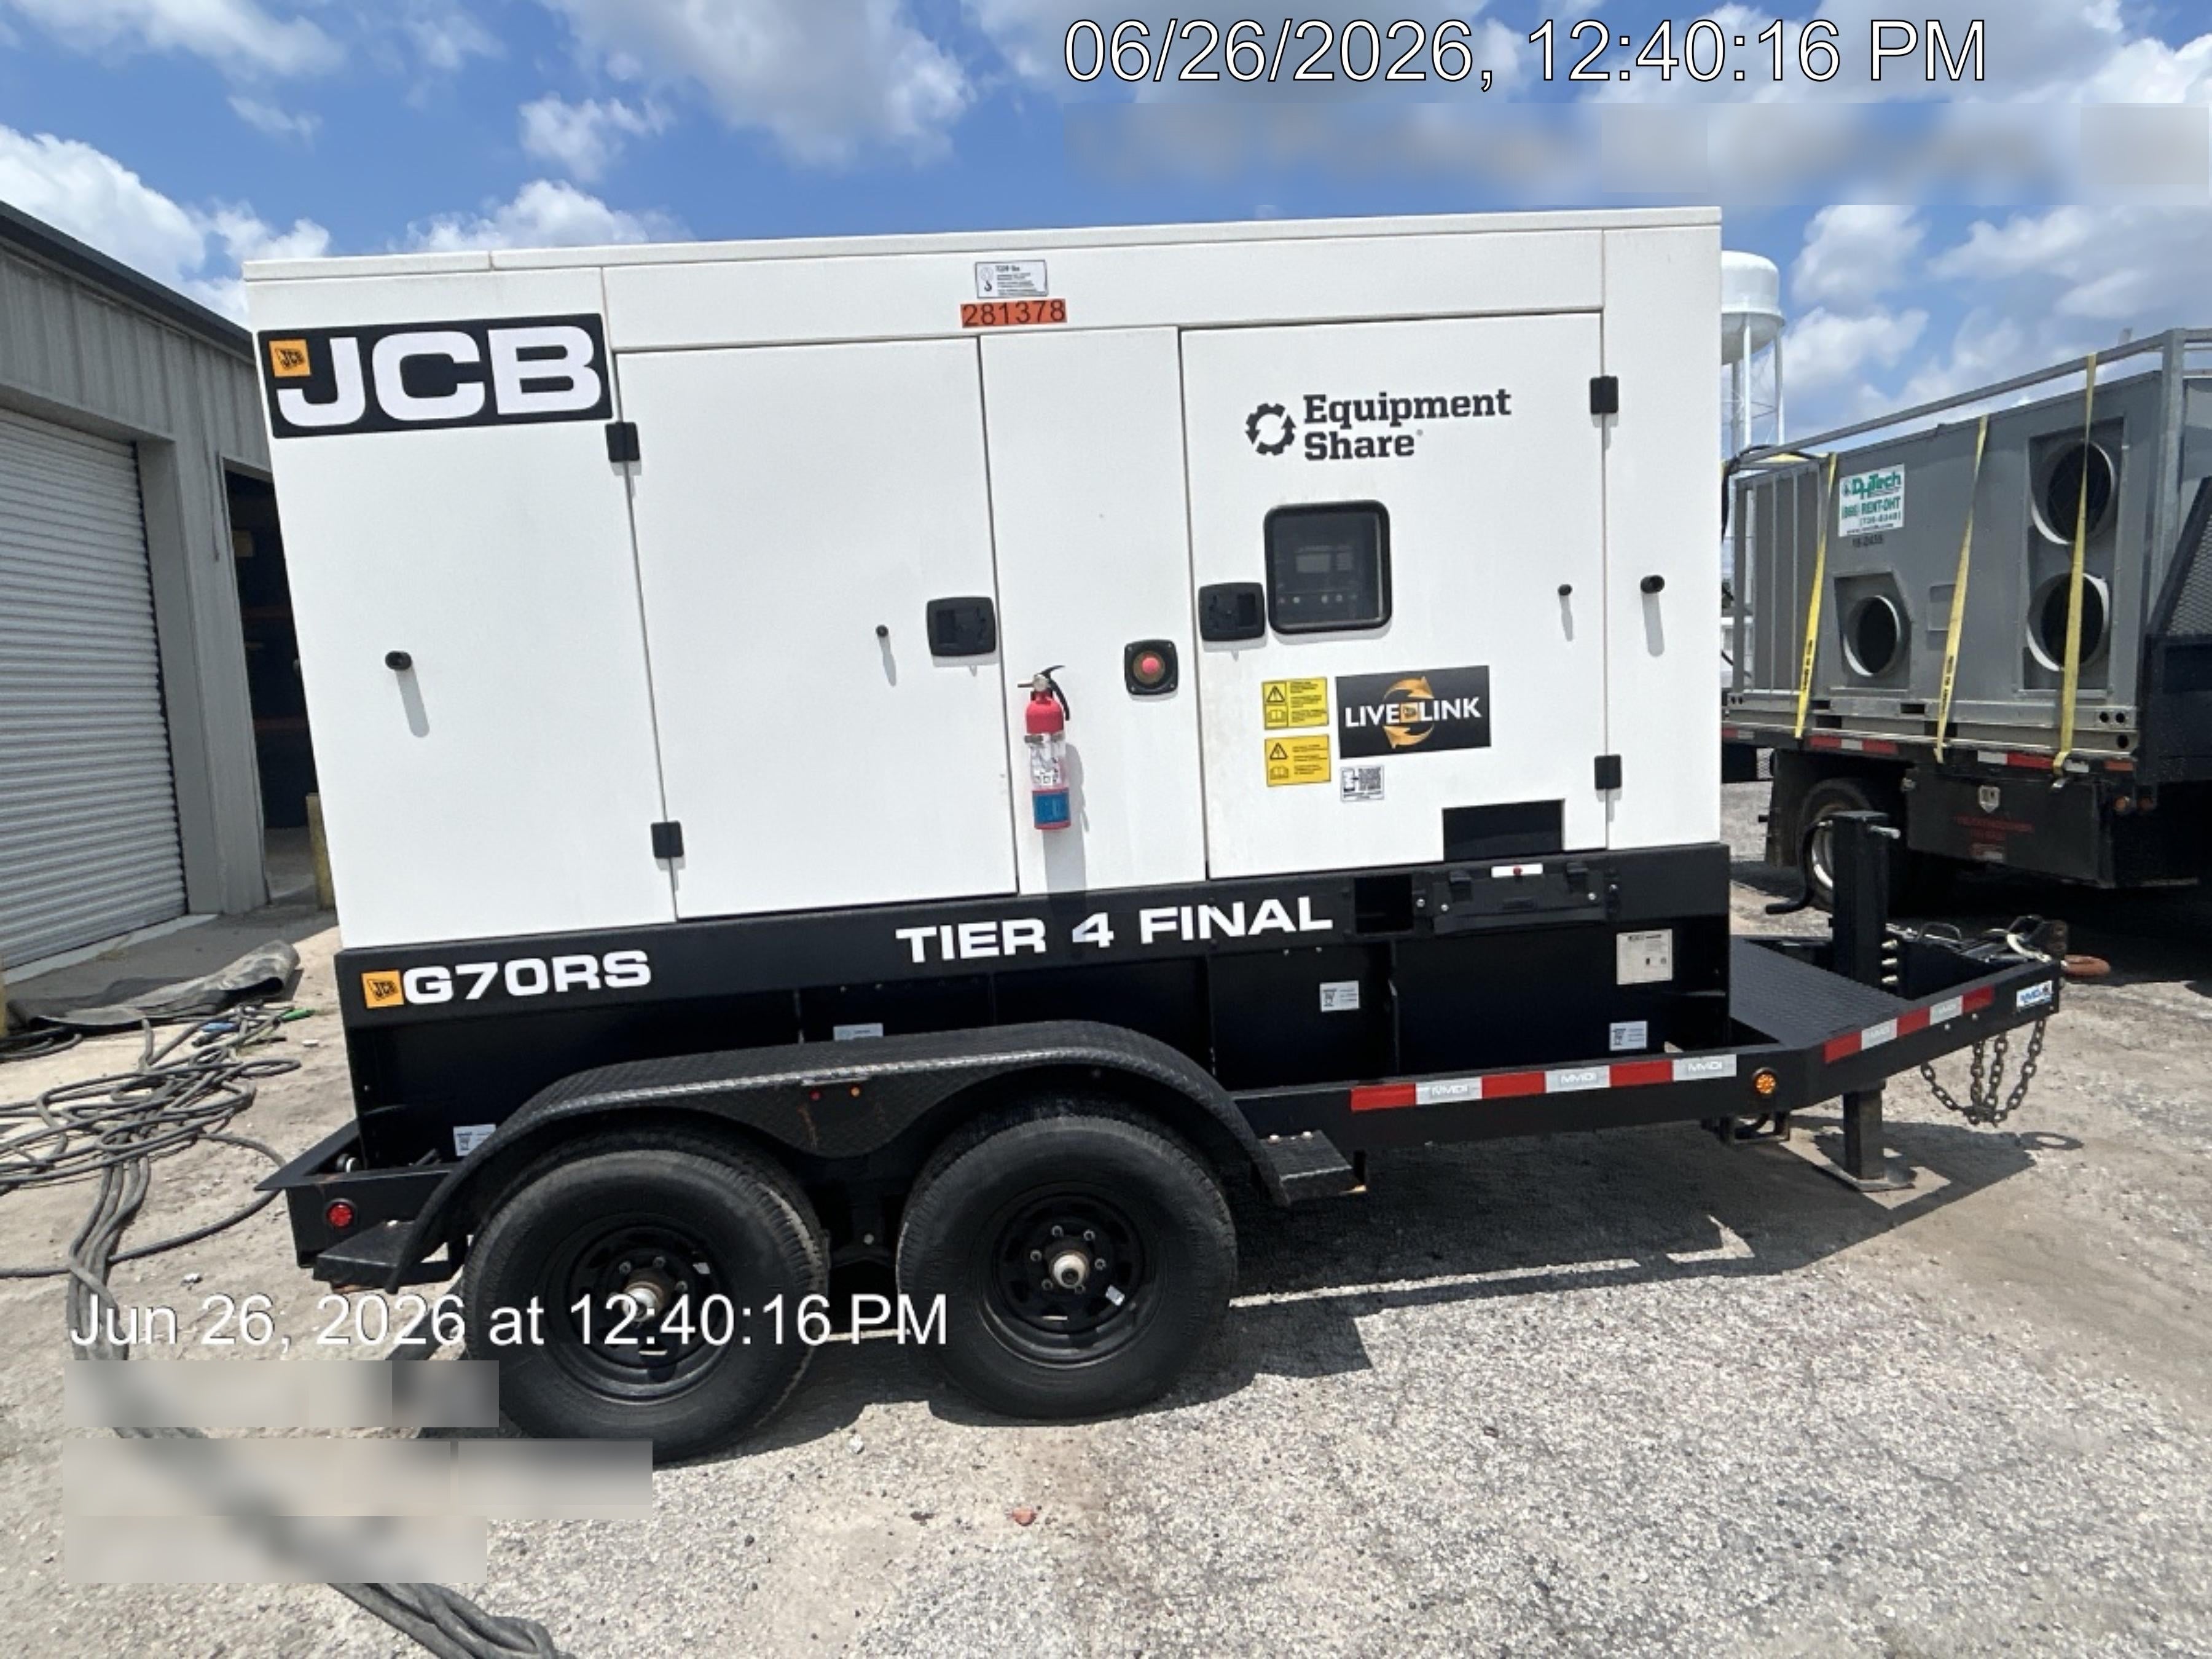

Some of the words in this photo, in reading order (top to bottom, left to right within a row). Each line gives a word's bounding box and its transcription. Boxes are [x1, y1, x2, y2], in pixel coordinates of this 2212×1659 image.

[962, 299, 1065, 326] 281378
[276, 325, 602, 428] JCB
[1303, 388, 1512, 429] Equipment
[1304, 431, 1415, 461] Share
[1344, 702, 1400, 728] LIVE
[1419, 696, 1482, 721] LINK
[895, 918, 1047, 963] TIER
[1072, 911, 1115, 949] 4
[1139, 896, 1333, 945] FINAL
[402, 949, 652, 1005] G70RS
